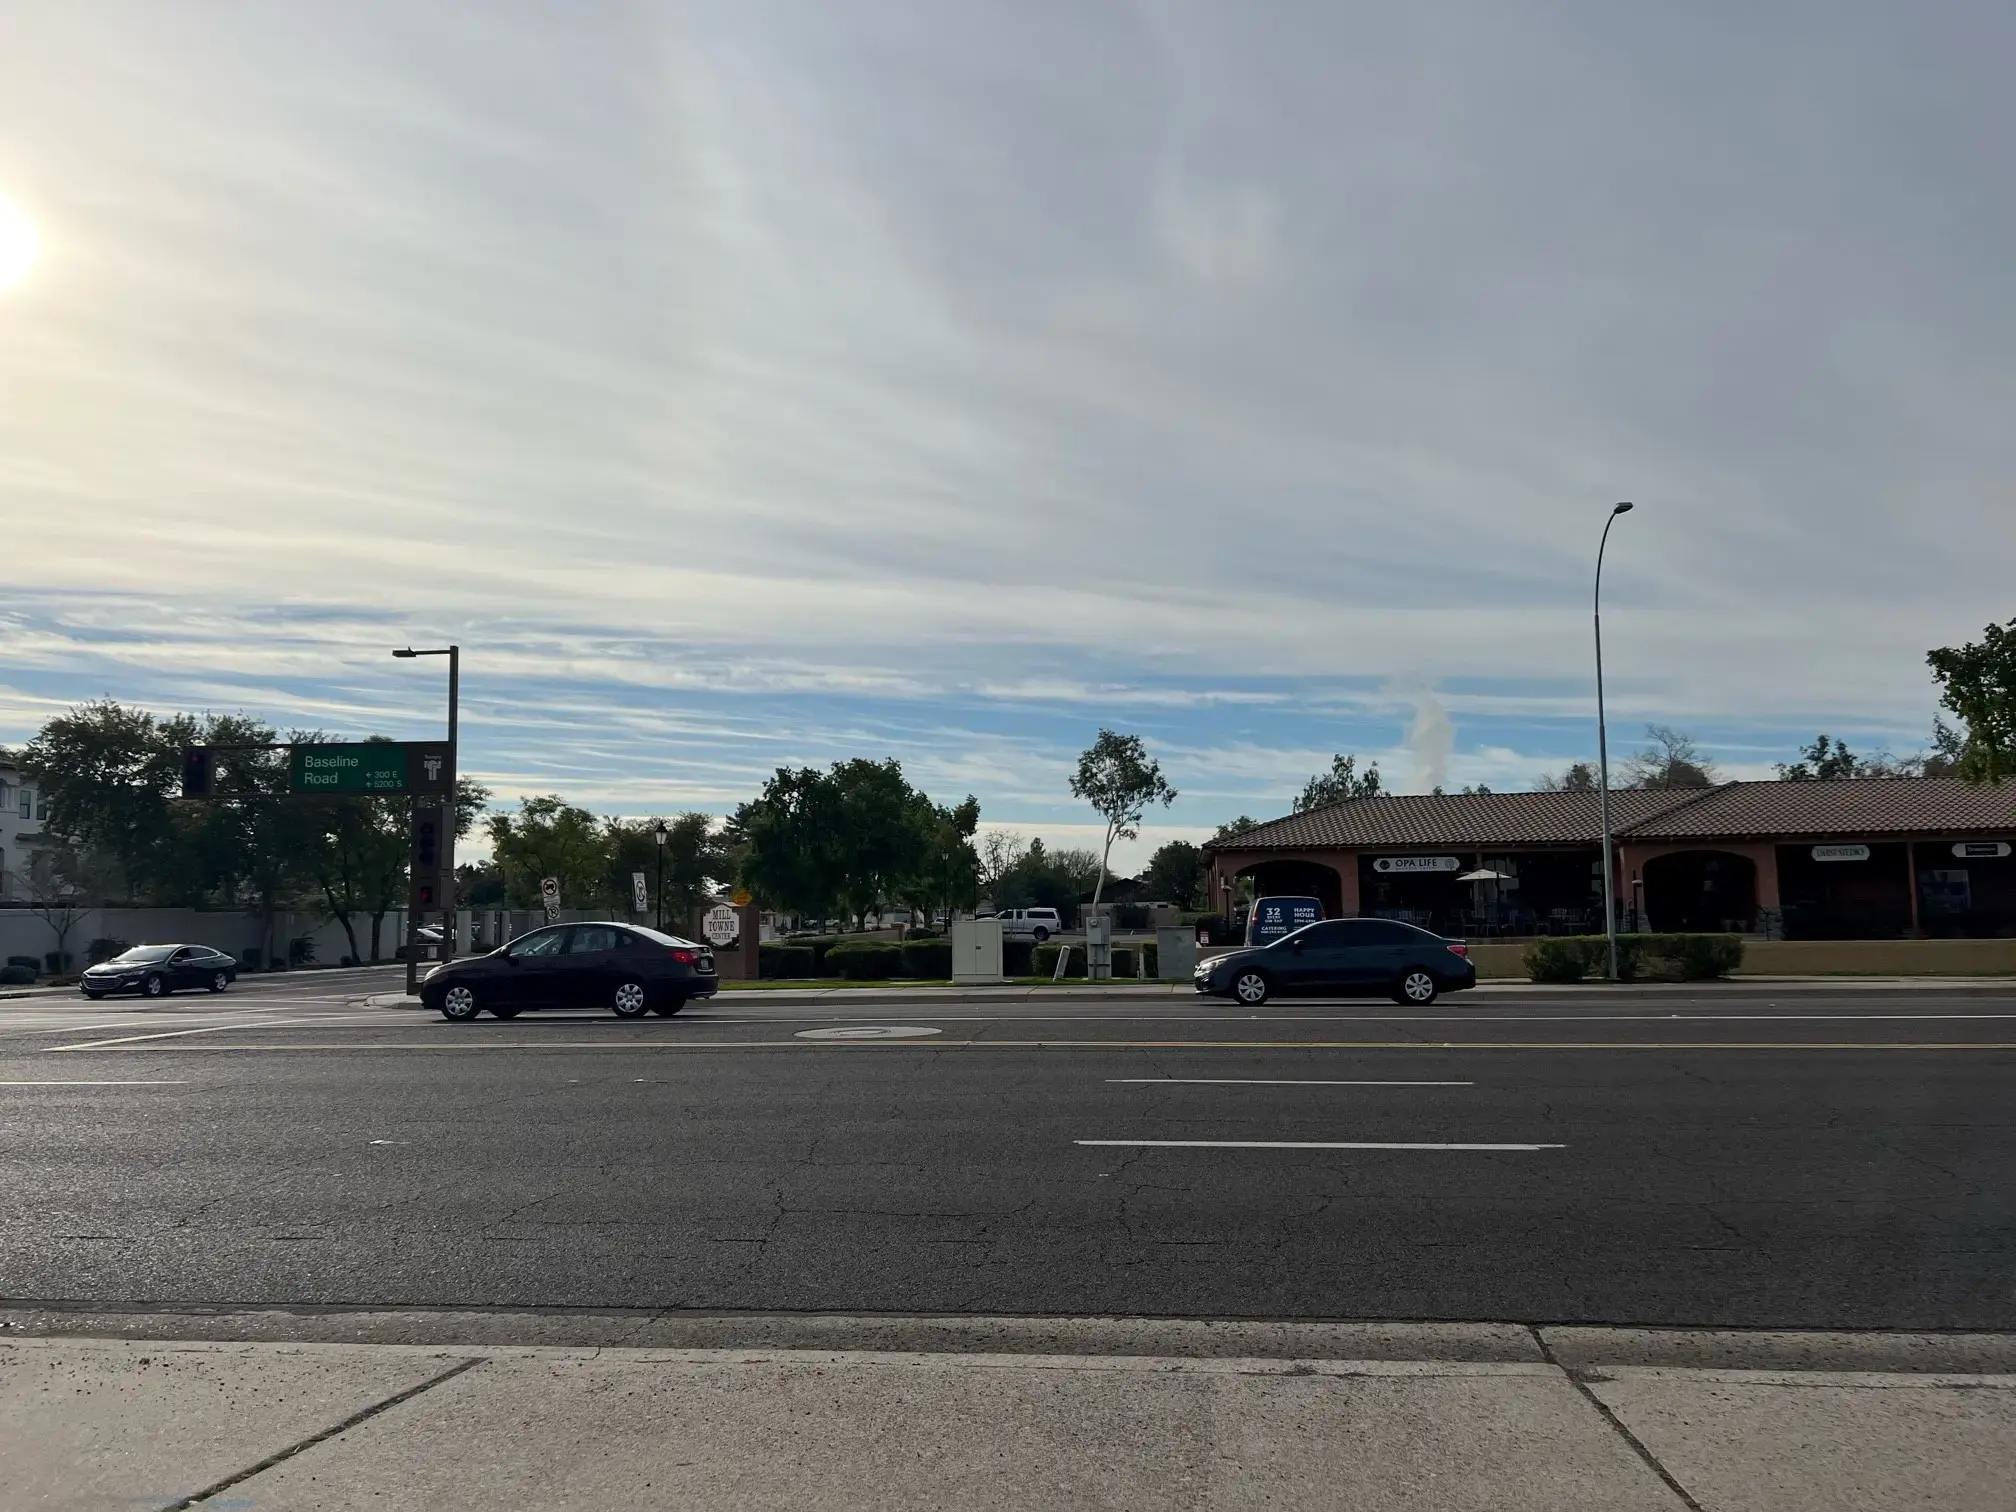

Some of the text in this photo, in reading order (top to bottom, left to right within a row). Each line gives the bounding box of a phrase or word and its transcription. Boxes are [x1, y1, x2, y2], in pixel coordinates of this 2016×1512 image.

[304, 756, 358, 767] Baseline
[304, 772, 338, 784] Road
[374, 780, 403, 788] 5200 S
[1418, 859, 1438, 867] LIFE
[712, 910, 730, 919] MILL
[709, 921, 734, 931] TOWNE
